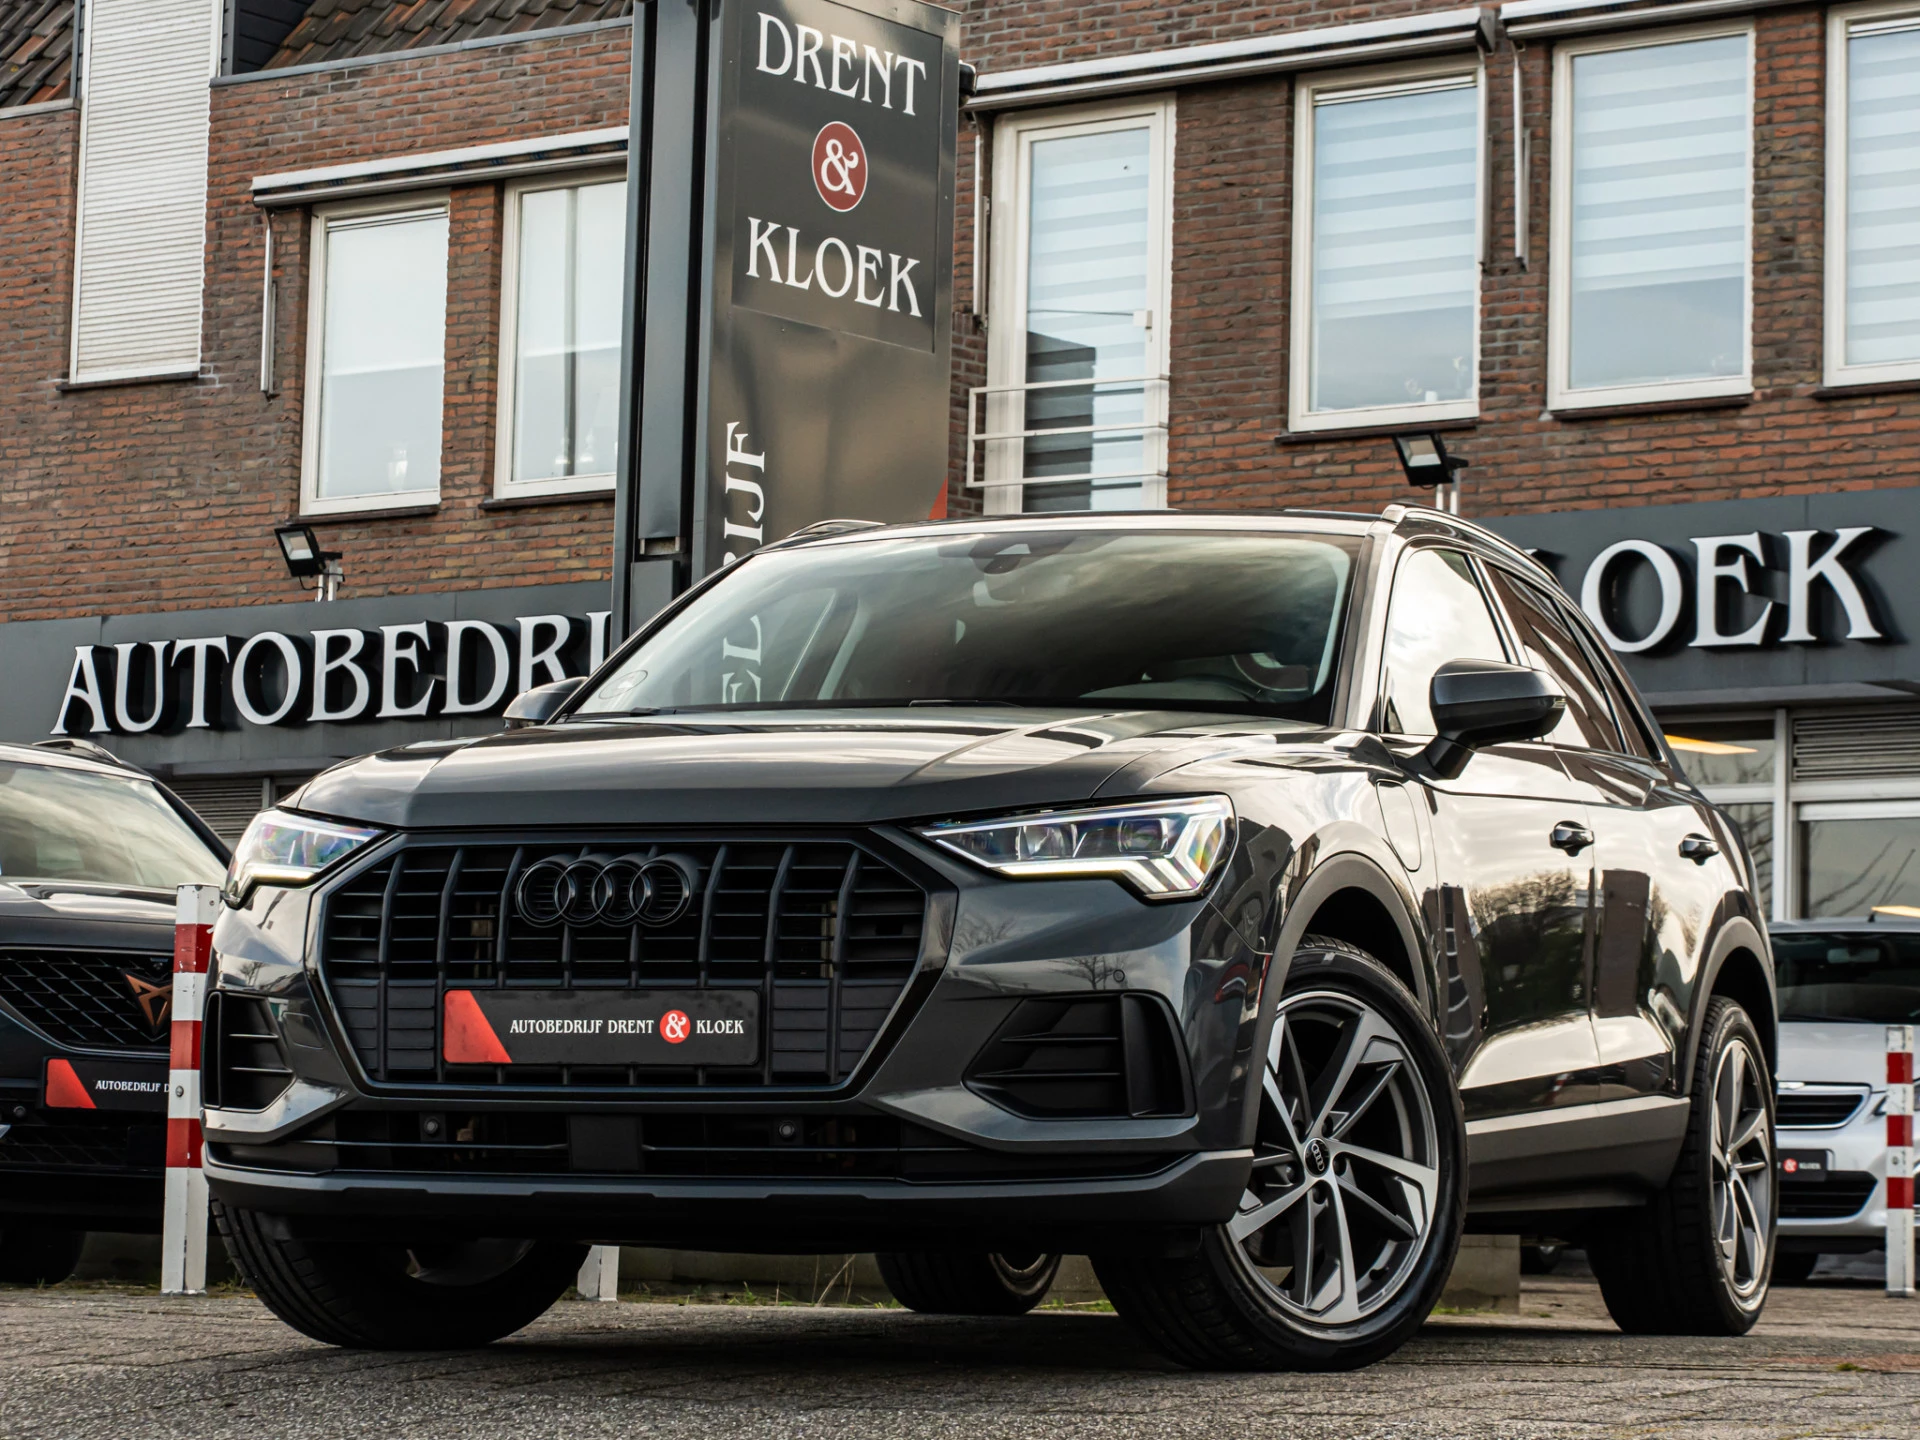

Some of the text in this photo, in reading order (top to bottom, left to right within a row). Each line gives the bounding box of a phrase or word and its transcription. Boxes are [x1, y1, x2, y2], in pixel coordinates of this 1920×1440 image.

[756, 12, 926, 116] DRENT
[820, 138, 859, 196] &
[746, 216, 922, 318] KLOEK
[510, 1013, 744, 1038] AUTOBEDRIJF DRENT & KLOEK
[95, 1080, 161, 1092] AUTOBEDRIJF
